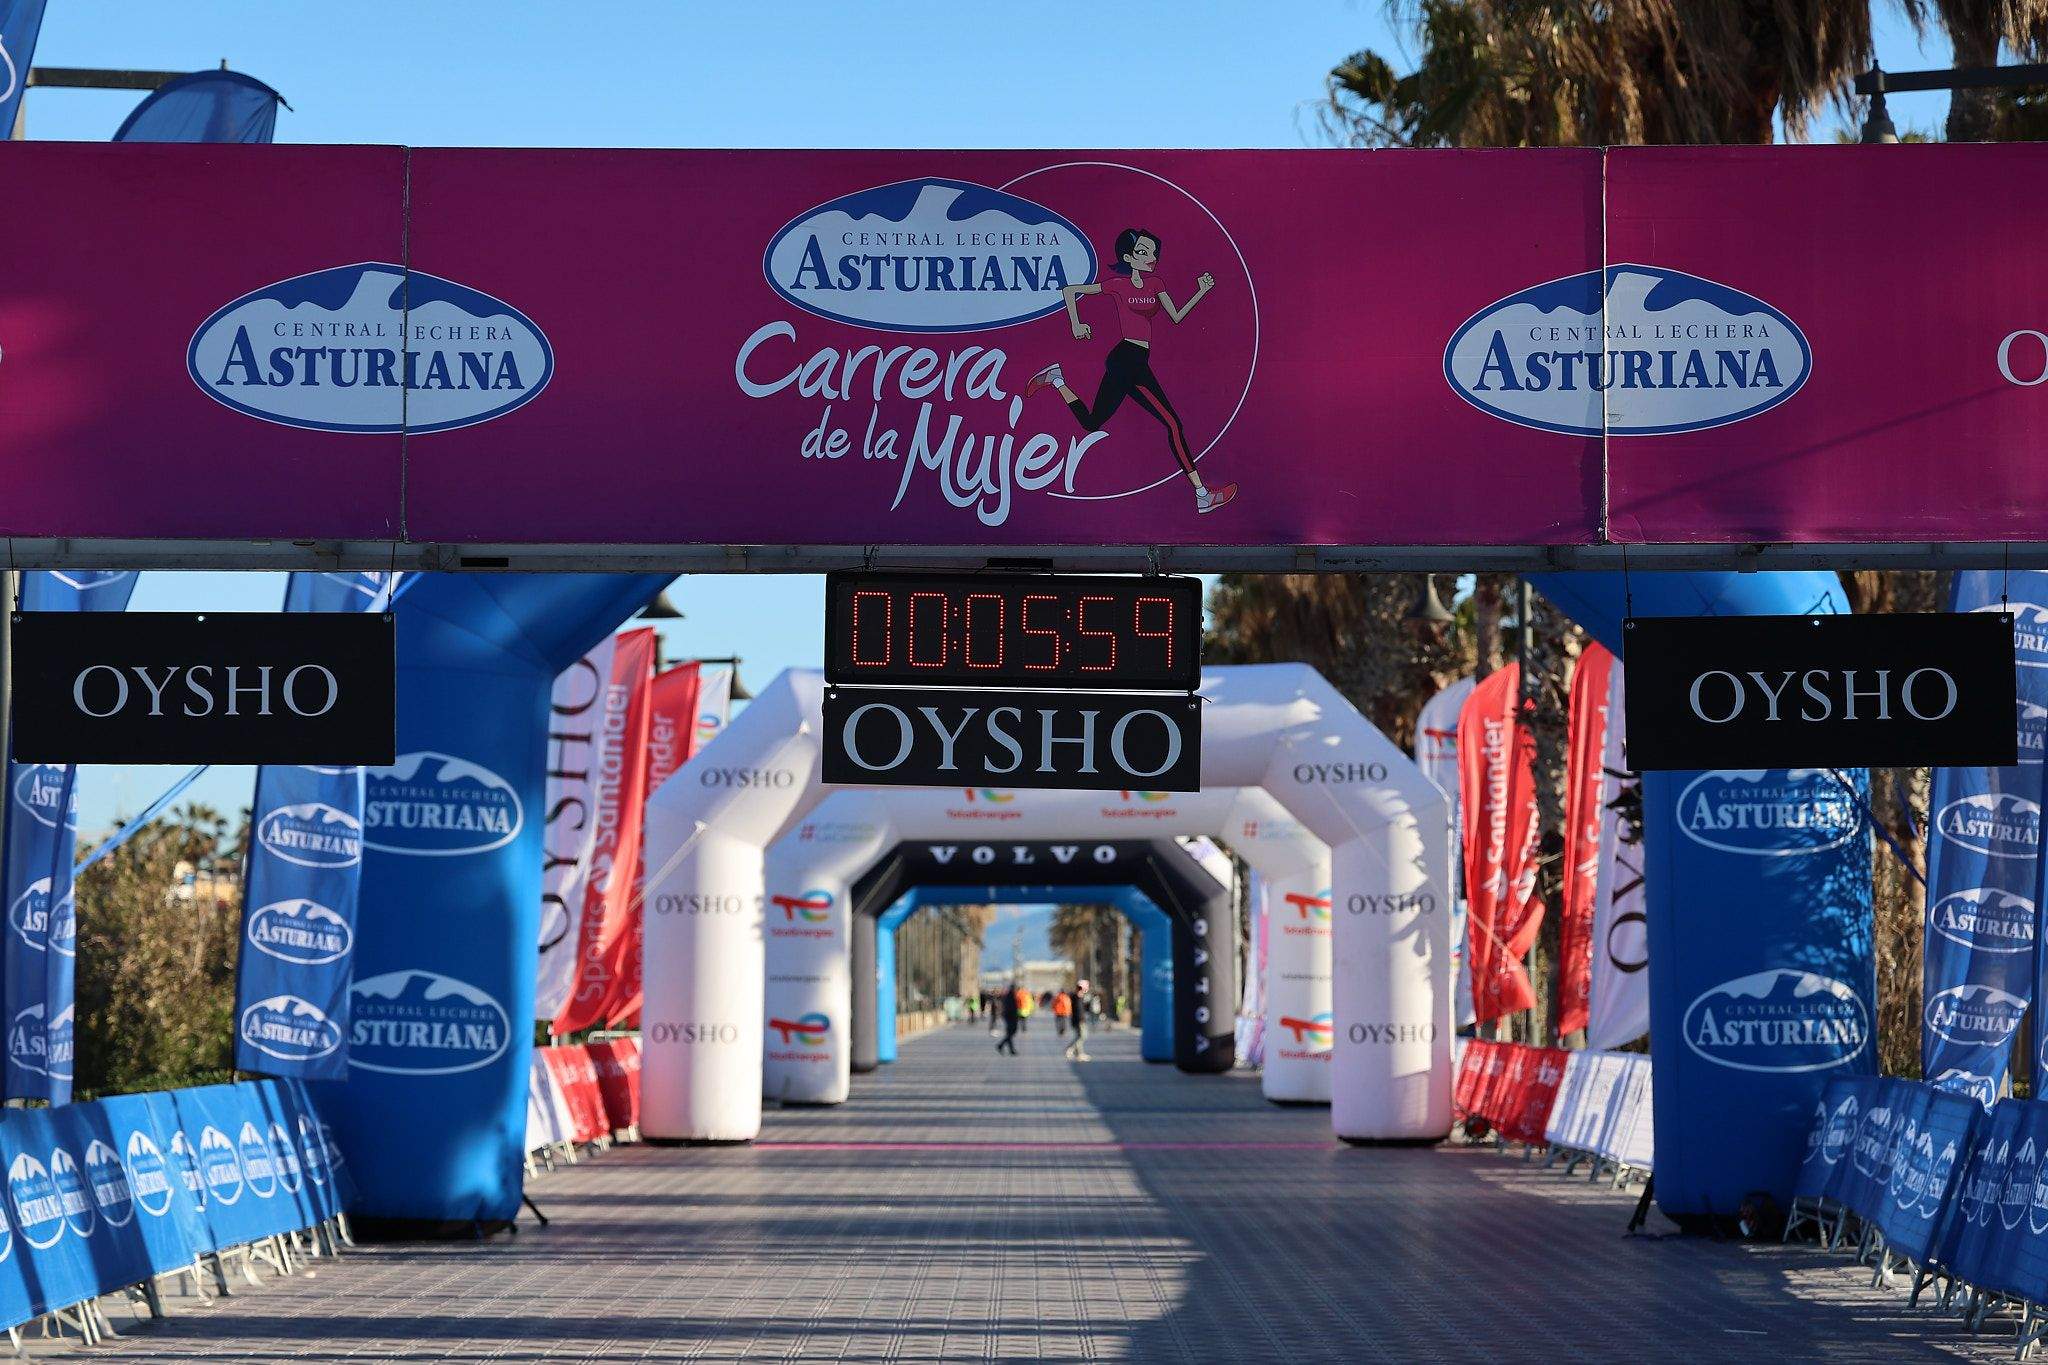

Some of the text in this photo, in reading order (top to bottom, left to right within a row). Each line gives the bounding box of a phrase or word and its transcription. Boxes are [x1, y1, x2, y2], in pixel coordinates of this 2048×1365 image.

[841, 231, 1061, 247] CENTRAL LECHERA
[790, 234, 1071, 293] ASTURIANA
[1128, 296, 1156, 304] OYSHO
[273, 322, 513, 341] CENTRAL LECHERA
[1529, 324, 1771, 342] CENTRAL LECHERA
[215, 324, 526, 391] ASTURIANA
[734, 320, 1008, 402] Carrera
[1472, 329, 1784, 392] ASTURIANA
[800, 394, 1109, 527] de la Mujer
[852, 590, 1174, 671] 00:05:59
[73, 664, 339, 718] OYSHO
[1689, 667, 1959, 724] OYSHO
[842, 703, 1183, 777] OYSHO
[700, 766, 795, 789] OYSHO
[1293, 761, 1389, 785] OYSHO
[1479, 716, 1517, 862] Santander
[363, 800, 512, 834] STURIANA
[929, 845, 1118, 865] VOLVO
[654, 894, 743, 916] OYSHO
[1347, 892, 1437, 917] OYSHO
[1940, 904, 2035, 941] ASTURIAN
[1192, 917, 1211, 1055] VOLVO
[1696, 1006, 1862, 1047] ASTURIANA
[1725, 1004, 1794, 1016] CENTRAL
[351, 1018, 498, 1051] STURIANA
[650, 1021, 739, 1045] OYSHO
[1348, 1022, 1437, 1047] OYSHO
